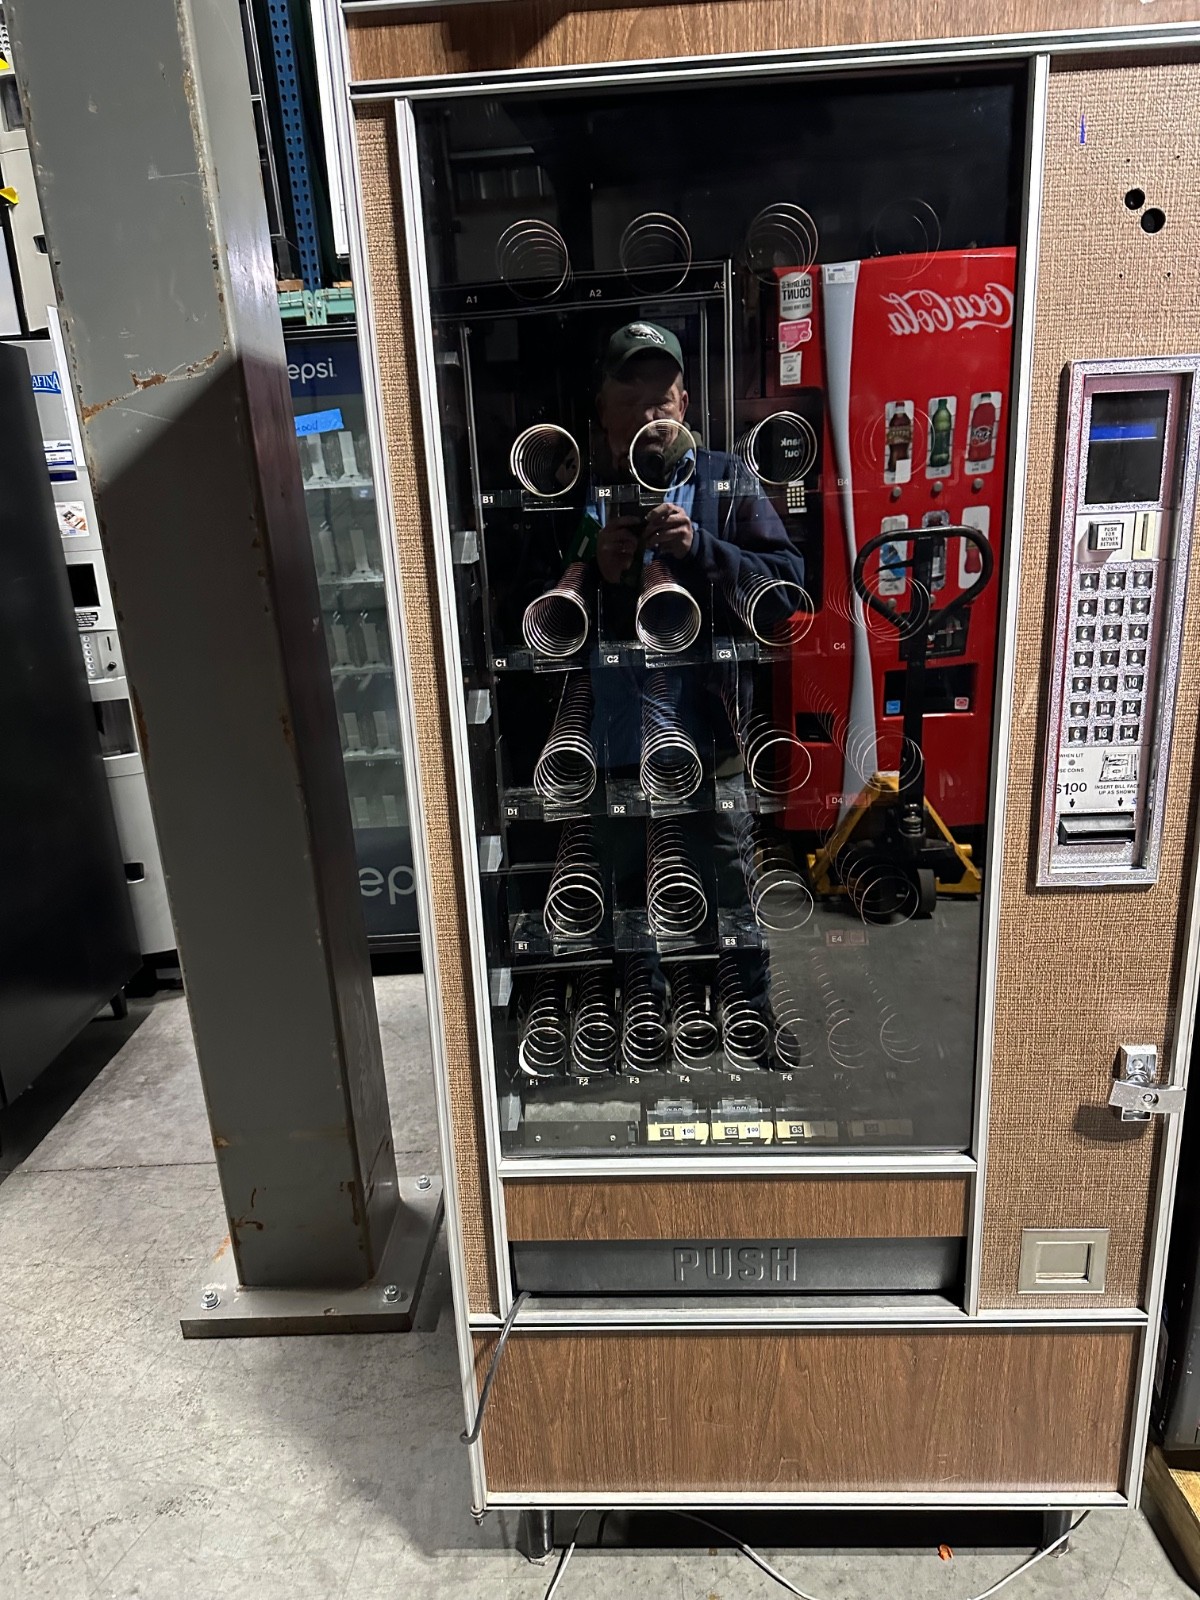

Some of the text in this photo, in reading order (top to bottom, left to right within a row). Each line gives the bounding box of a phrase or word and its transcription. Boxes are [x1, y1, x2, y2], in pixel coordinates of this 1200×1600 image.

[589, 289, 602, 298] A2
[466, 296, 478, 304] A1
[717, 482, 730, 490] B3
[598, 488, 611, 497] B2
[482, 496, 494, 504] B1
[1108, 627, 1114, 638] 5
[1134, 626, 1141, 636] 6
[606, 655, 619, 663] C2
[719, 650, 732, 659] C3
[1106, 653, 1112, 663] 7
[495, 659, 506, 667] C1
[1104, 678, 1110, 688] 9
[1128, 677, 1138, 687] 10
[1100, 703, 1110, 713] 11
[1126, 702, 1136, 712] 12
[1098, 728, 1108, 738] 13
[1124, 727, 1133, 737] 14
[1056, 782, 1087, 795] $1.00
[673, 1247, 797, 1281] PUSH
